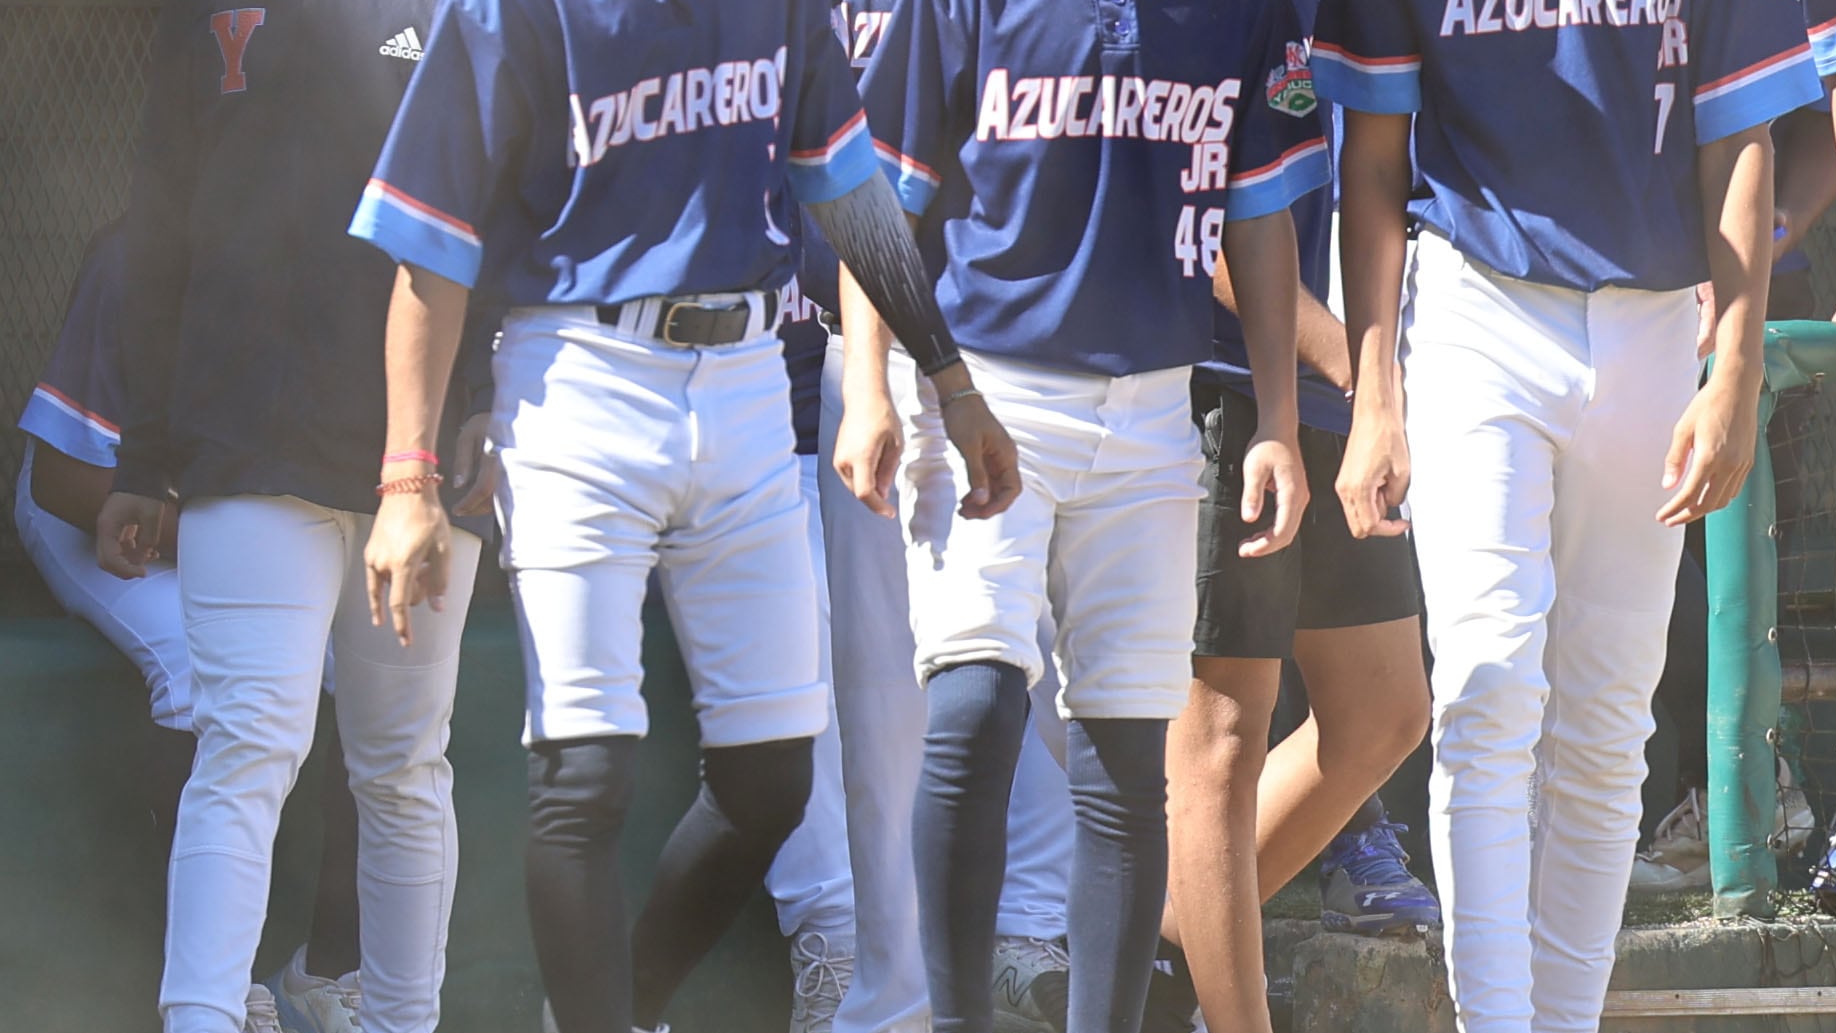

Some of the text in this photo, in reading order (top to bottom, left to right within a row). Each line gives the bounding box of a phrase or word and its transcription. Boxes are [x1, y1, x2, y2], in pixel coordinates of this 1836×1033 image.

[209, 7, 266, 95] Y
[976, 69, 1242, 144] AZUCAREROS
[1180, 142, 1229, 194] JR
